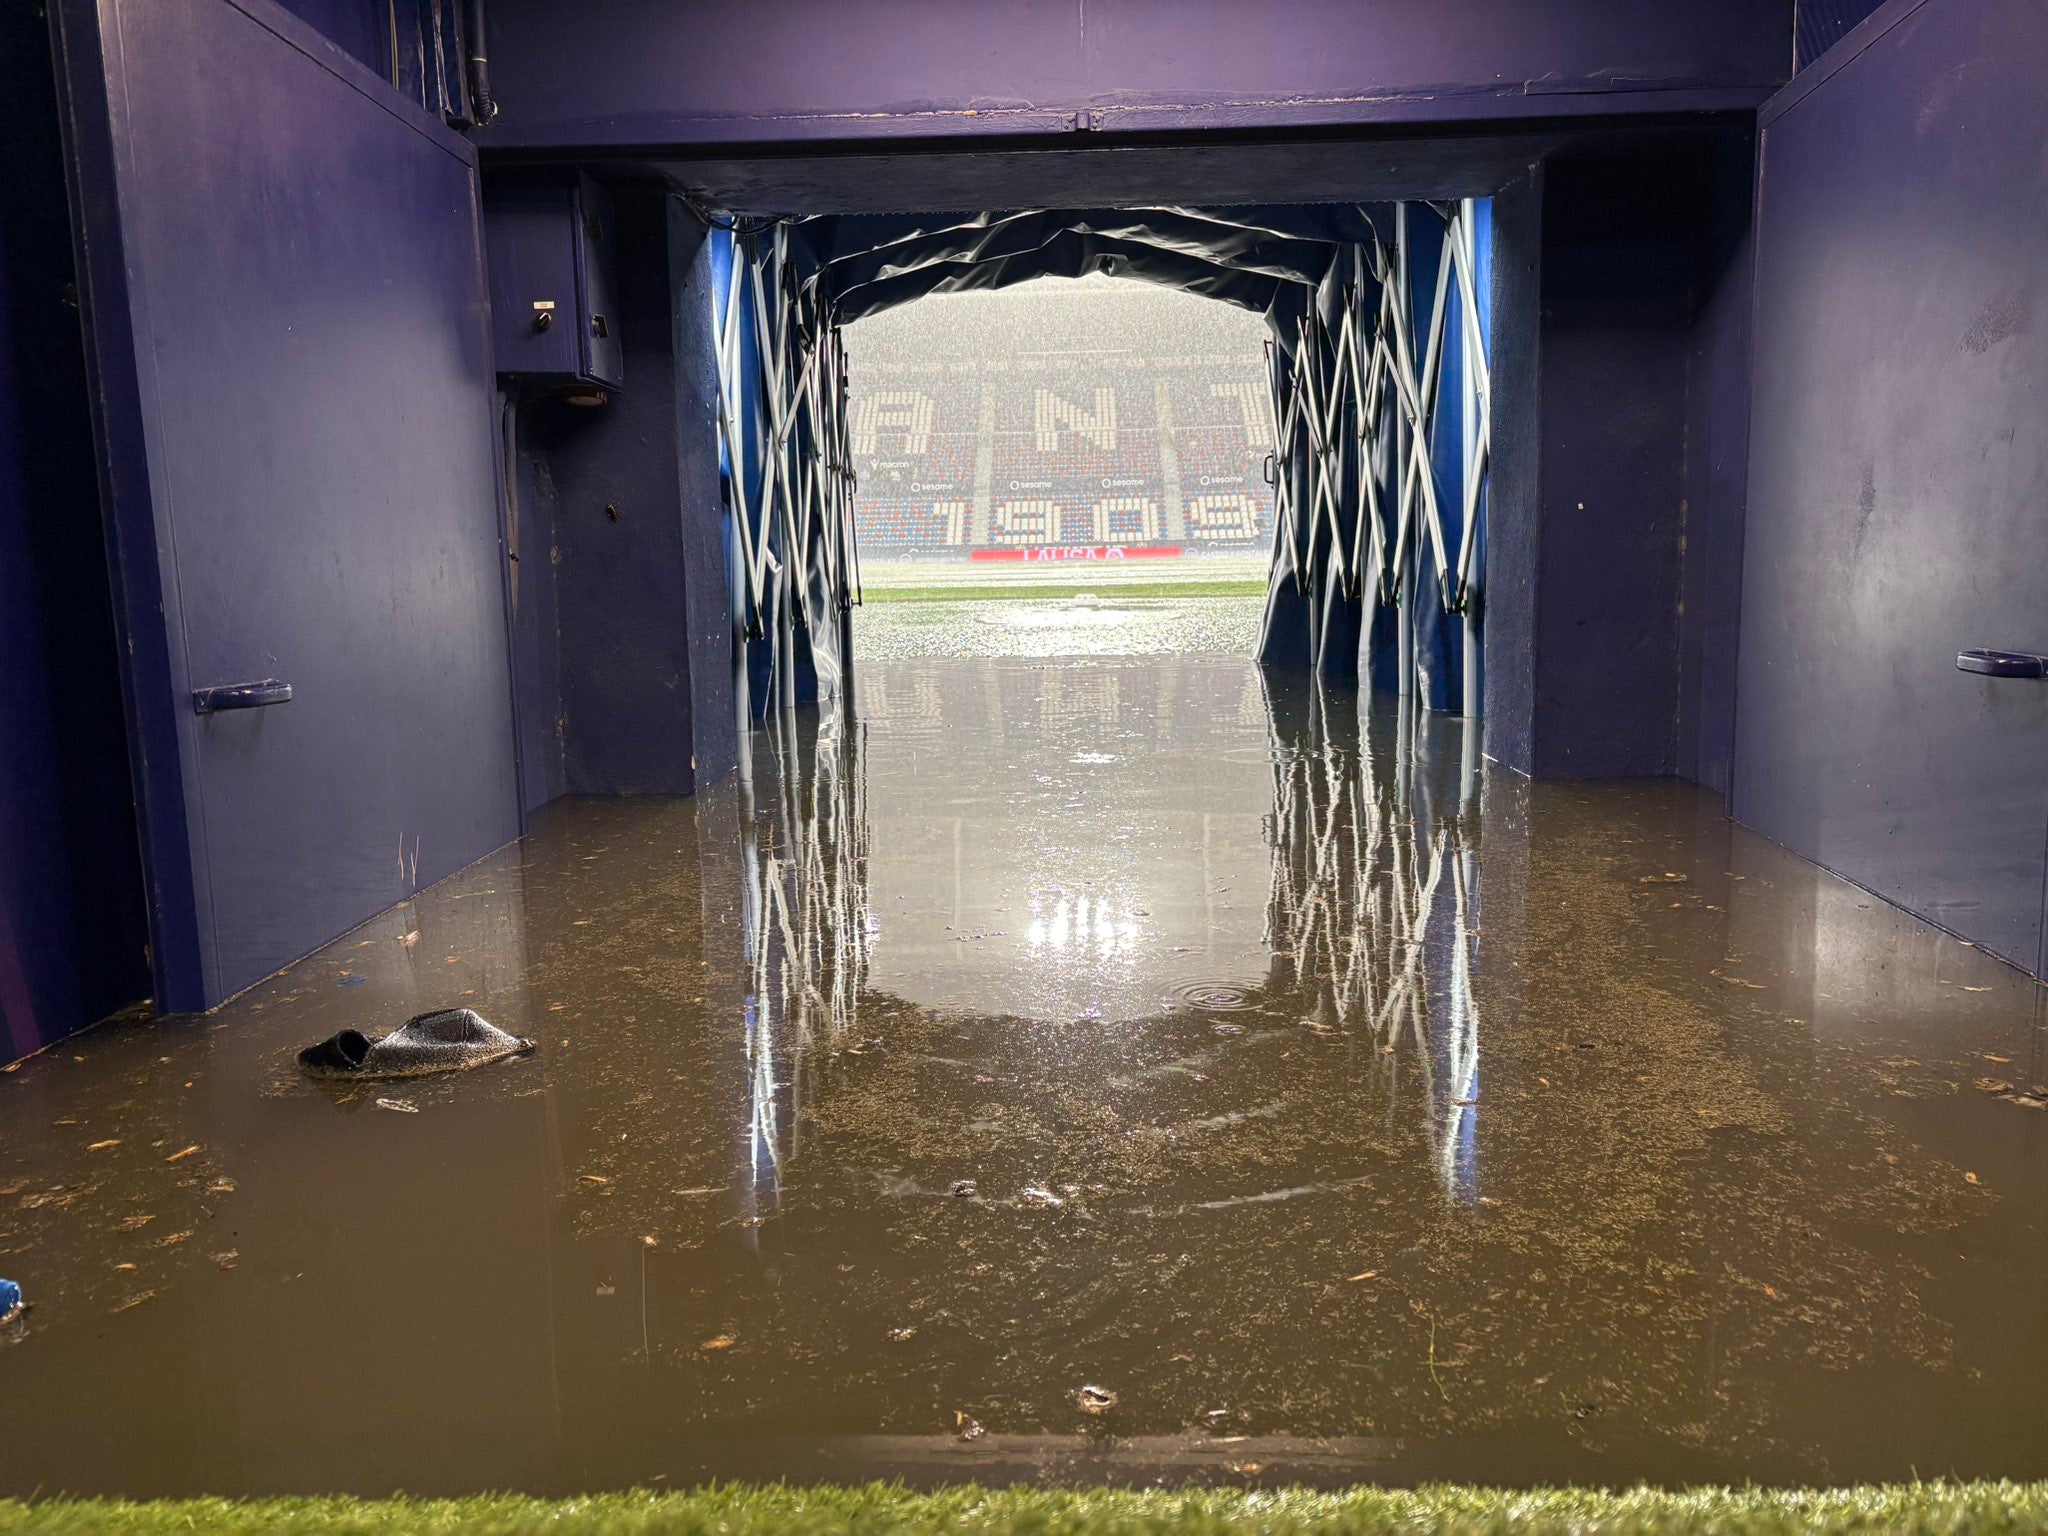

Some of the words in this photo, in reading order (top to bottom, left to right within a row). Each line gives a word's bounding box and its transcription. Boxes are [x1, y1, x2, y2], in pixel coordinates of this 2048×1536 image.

[1112, 479, 1145, 487] sesame
[1211, 476, 1243, 484] sesame
[921, 483, 954, 492] sesame
[1020, 481, 1053, 489] sesame
